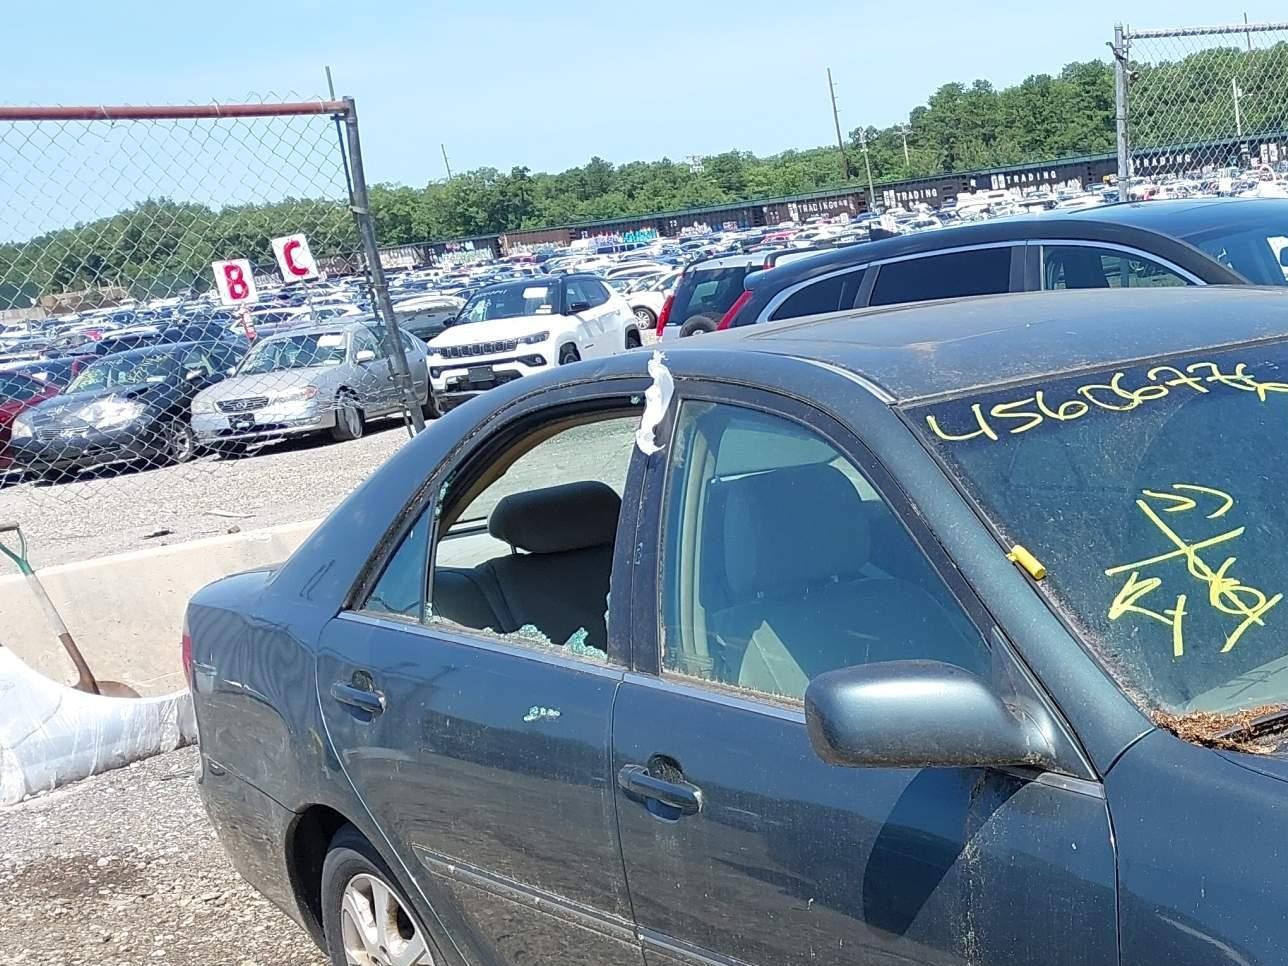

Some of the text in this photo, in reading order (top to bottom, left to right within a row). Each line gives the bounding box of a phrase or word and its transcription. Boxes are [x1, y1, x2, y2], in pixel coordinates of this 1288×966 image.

[1135, 153, 1192, 169] TRADING
[1005, 170, 1058, 185] TRADING
[895, 188, 938, 202] TRADING
[797, 200, 835, 215] TRADING
[283, 239, 310, 276] C
